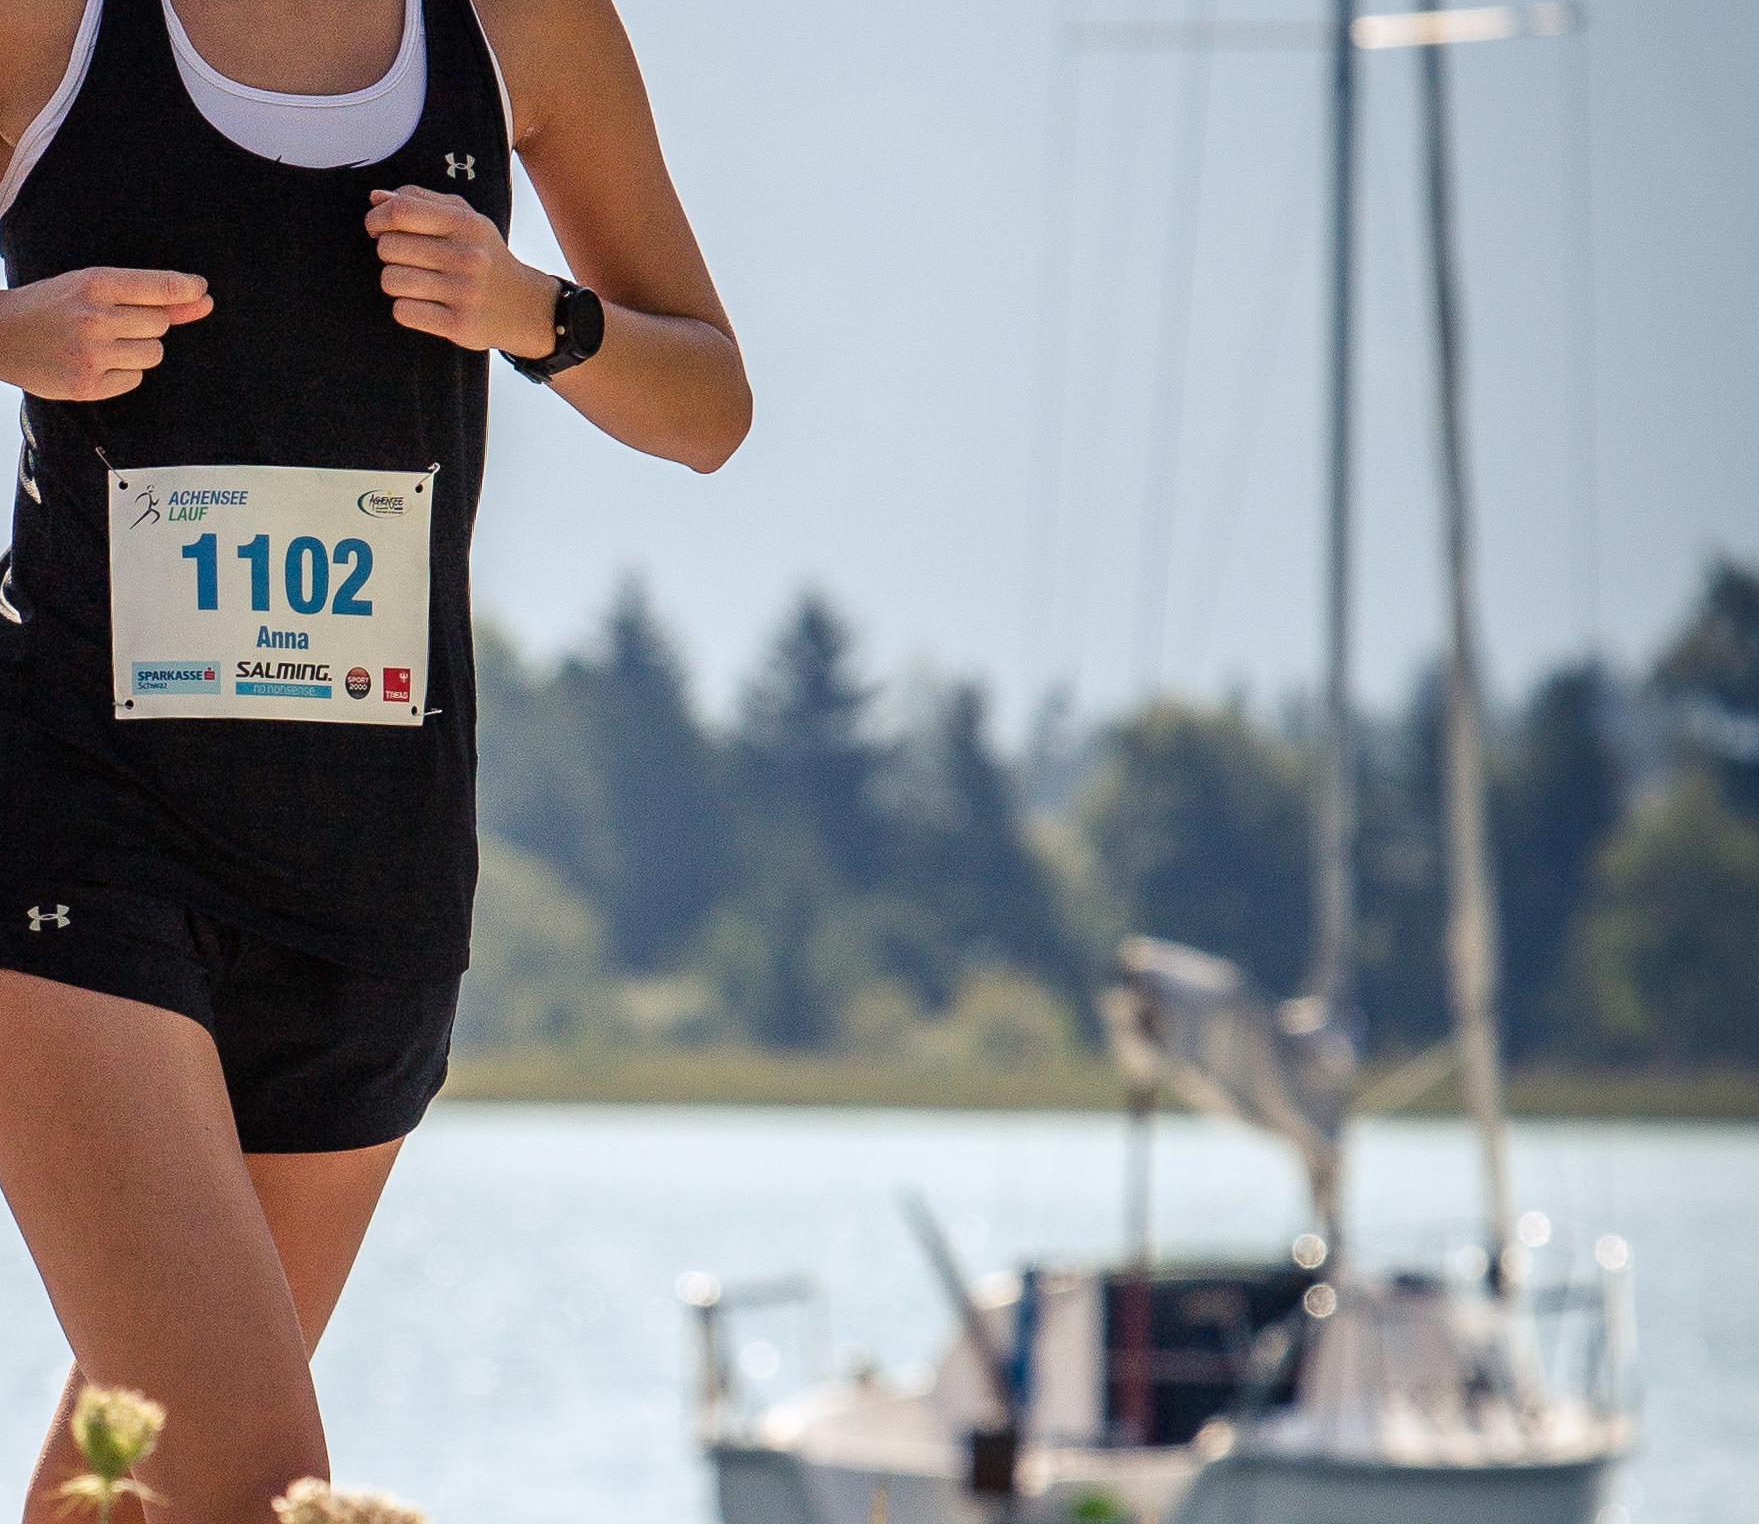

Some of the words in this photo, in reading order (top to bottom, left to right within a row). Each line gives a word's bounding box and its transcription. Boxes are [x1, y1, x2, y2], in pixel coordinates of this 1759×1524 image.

[168, 490, 249, 506] ACHENSEE
[168, 506, 209, 522] LAUF
[181, 533, 374, 616] 1102
[256, 626, 310, 650] Anna
[137, 670, 203, 681] SPARKASSE
